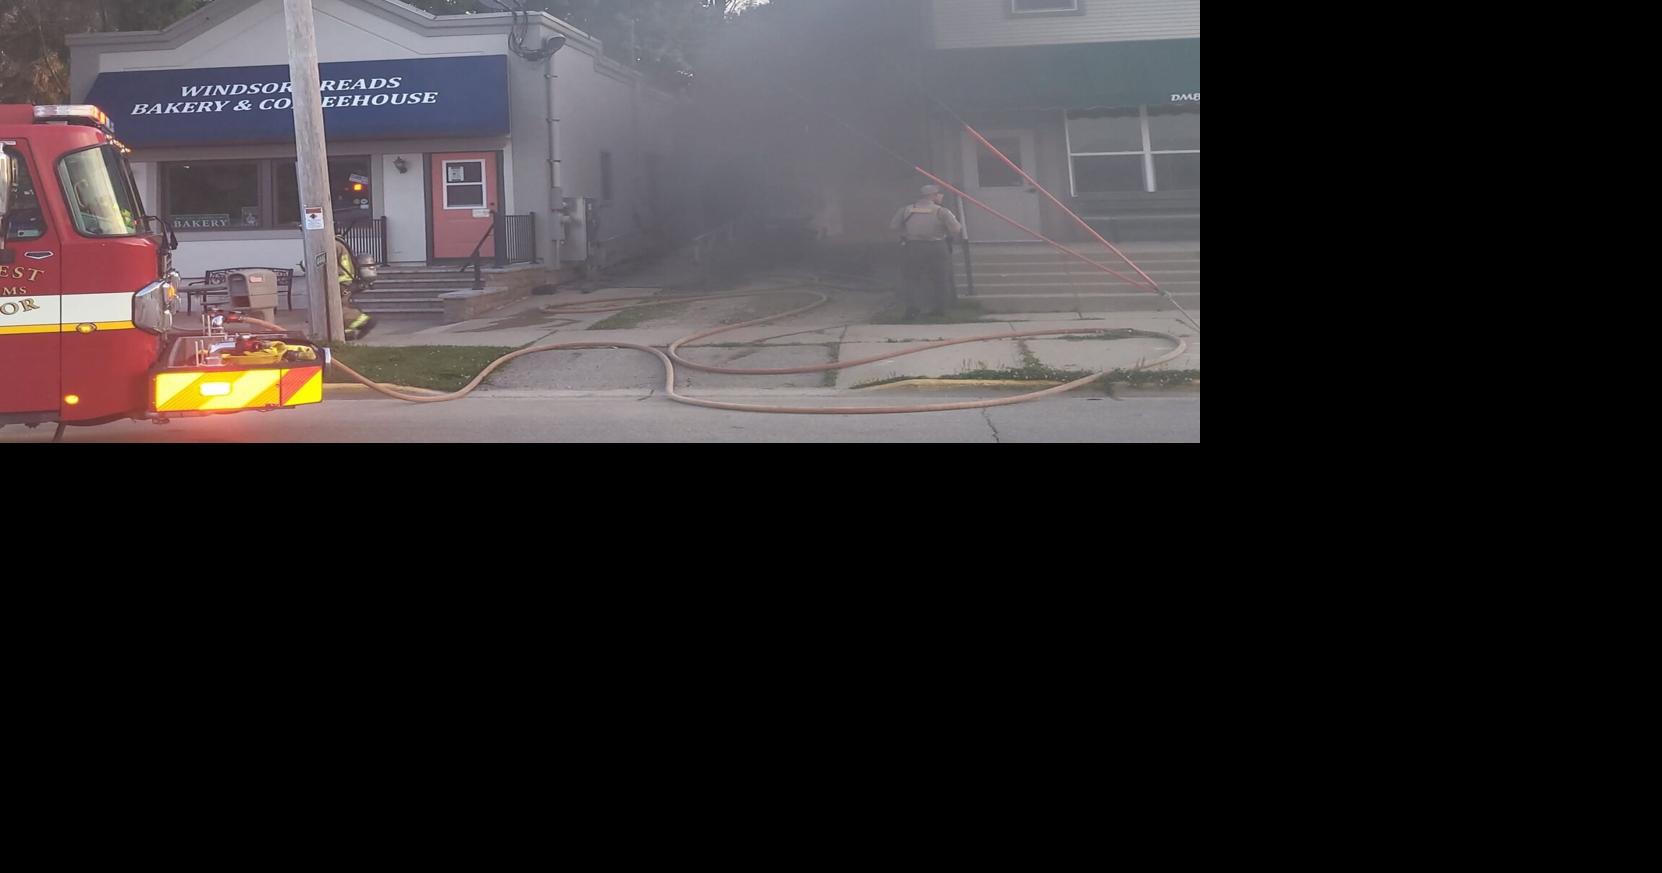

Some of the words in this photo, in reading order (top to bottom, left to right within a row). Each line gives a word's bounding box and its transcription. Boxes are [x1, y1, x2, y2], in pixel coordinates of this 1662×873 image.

[181, 81, 293, 97] WINDSOR
[319, 76, 402, 91] READS
[130, 100, 231, 116] BAKERY
[233, 99, 253, 111] &
[259, 91, 438, 110] COEEHOUSE
[174, 219, 228, 228] BAKERY
